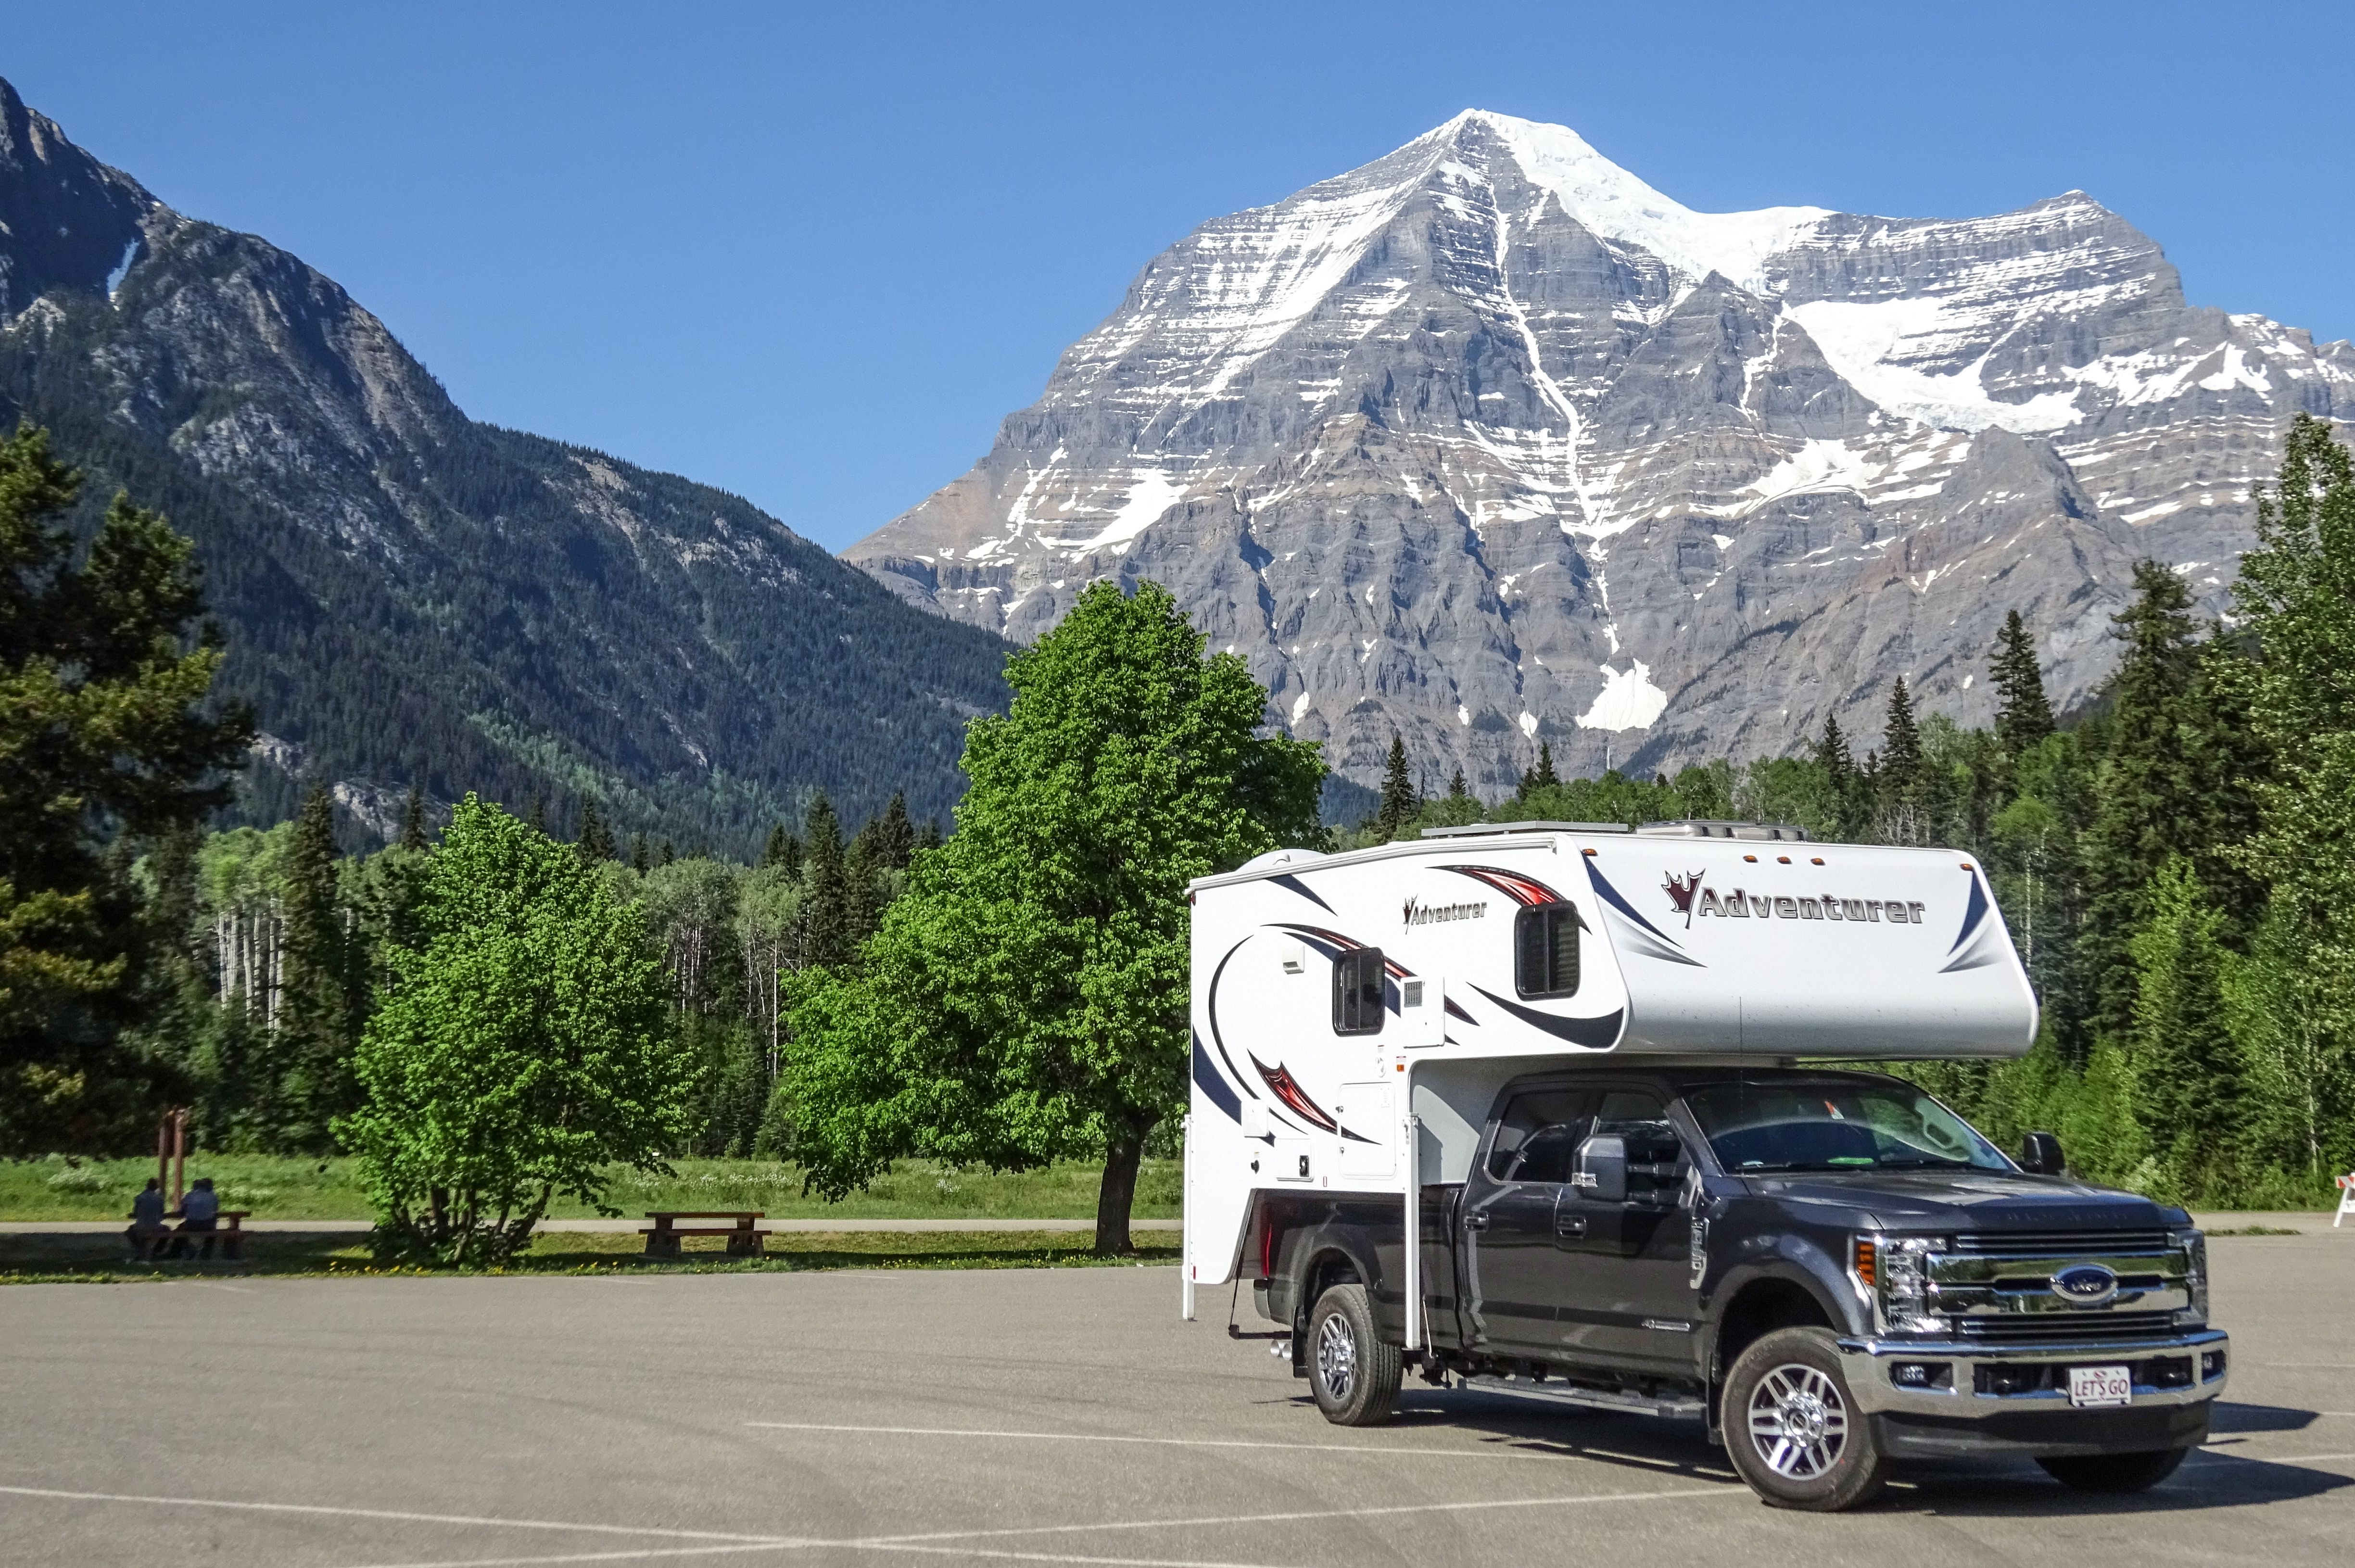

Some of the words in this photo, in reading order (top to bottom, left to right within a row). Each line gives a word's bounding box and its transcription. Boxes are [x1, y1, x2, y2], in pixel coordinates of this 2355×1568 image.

[1411, 902, 1487, 925] Adventurer
[1697, 886, 1925, 923] Adventurer
[2109, 1378, 2128, 1395] GO
